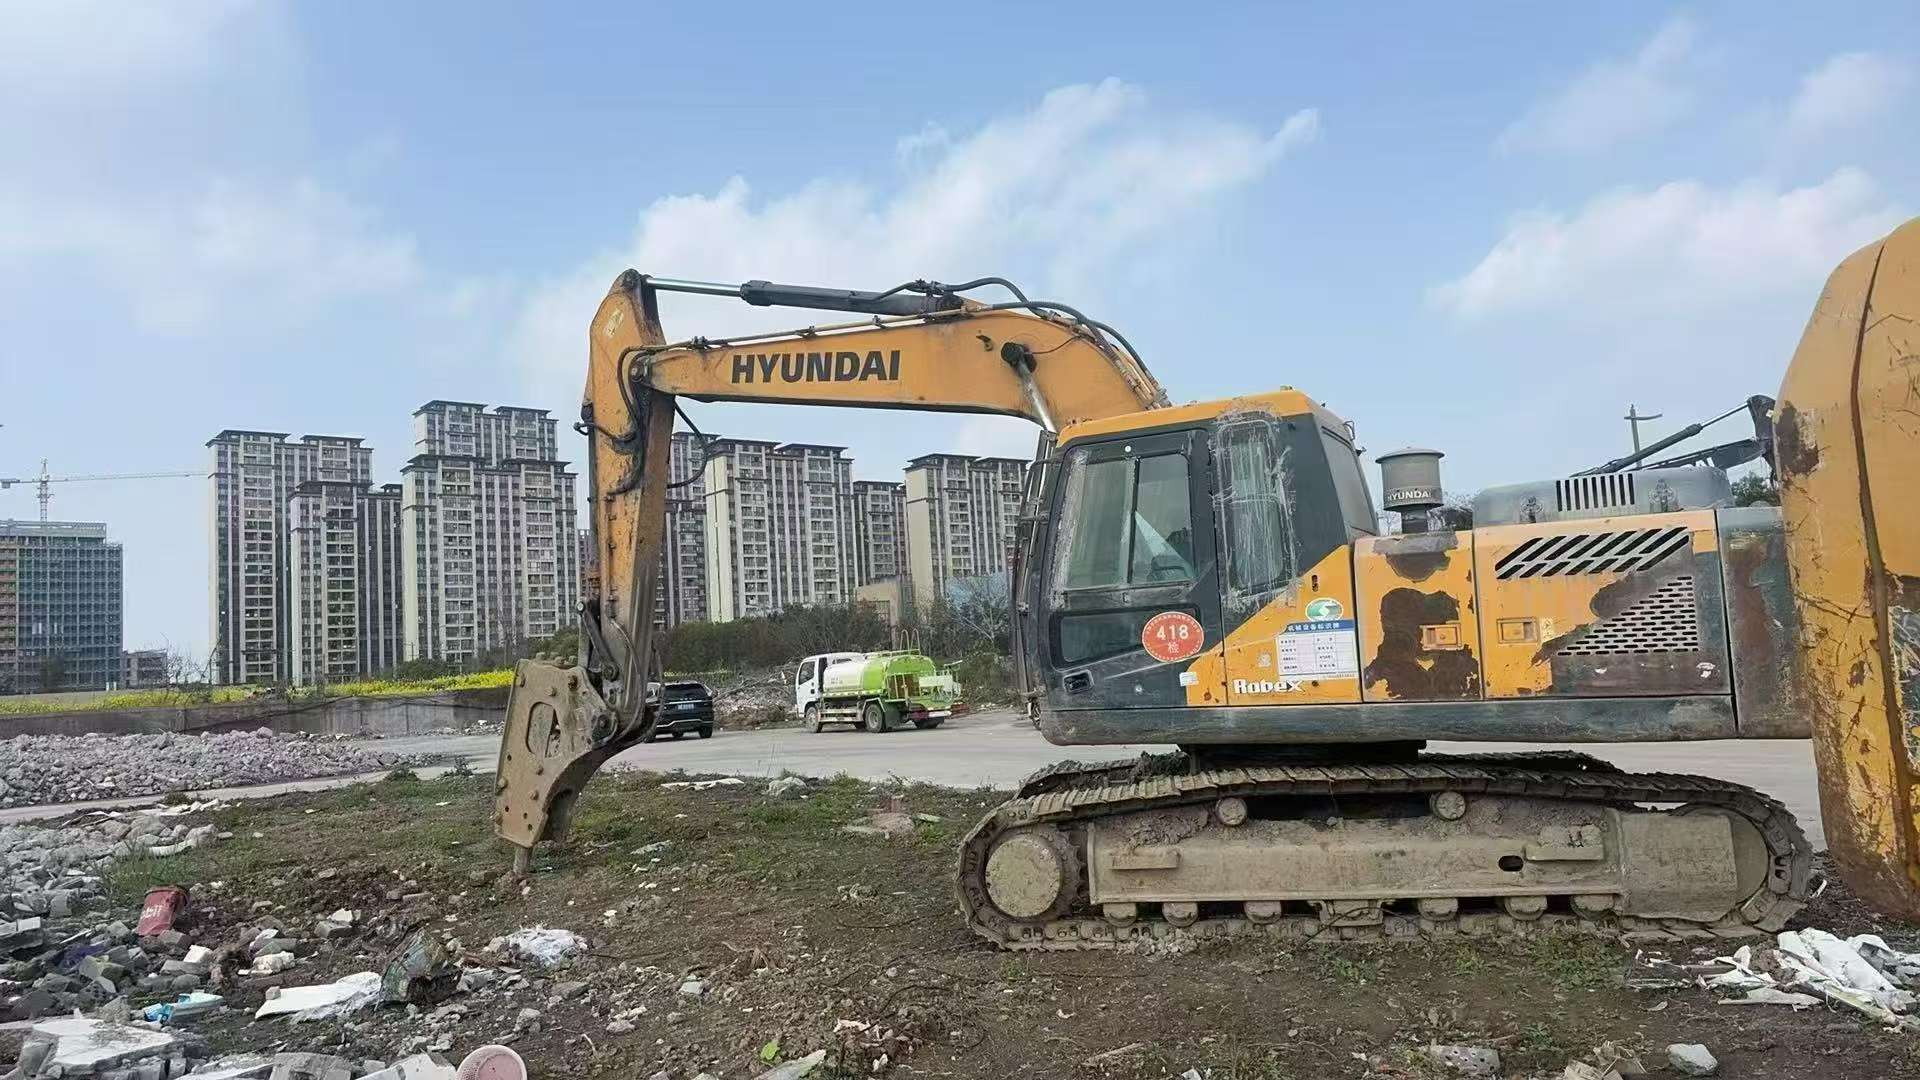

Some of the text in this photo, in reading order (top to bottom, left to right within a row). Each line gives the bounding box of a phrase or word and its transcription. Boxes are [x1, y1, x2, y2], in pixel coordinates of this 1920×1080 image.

[731, 350, 901, 384] HYUNDAI
[1156, 624, 1189, 641] 418
[1233, 678, 1305, 695] Robex
